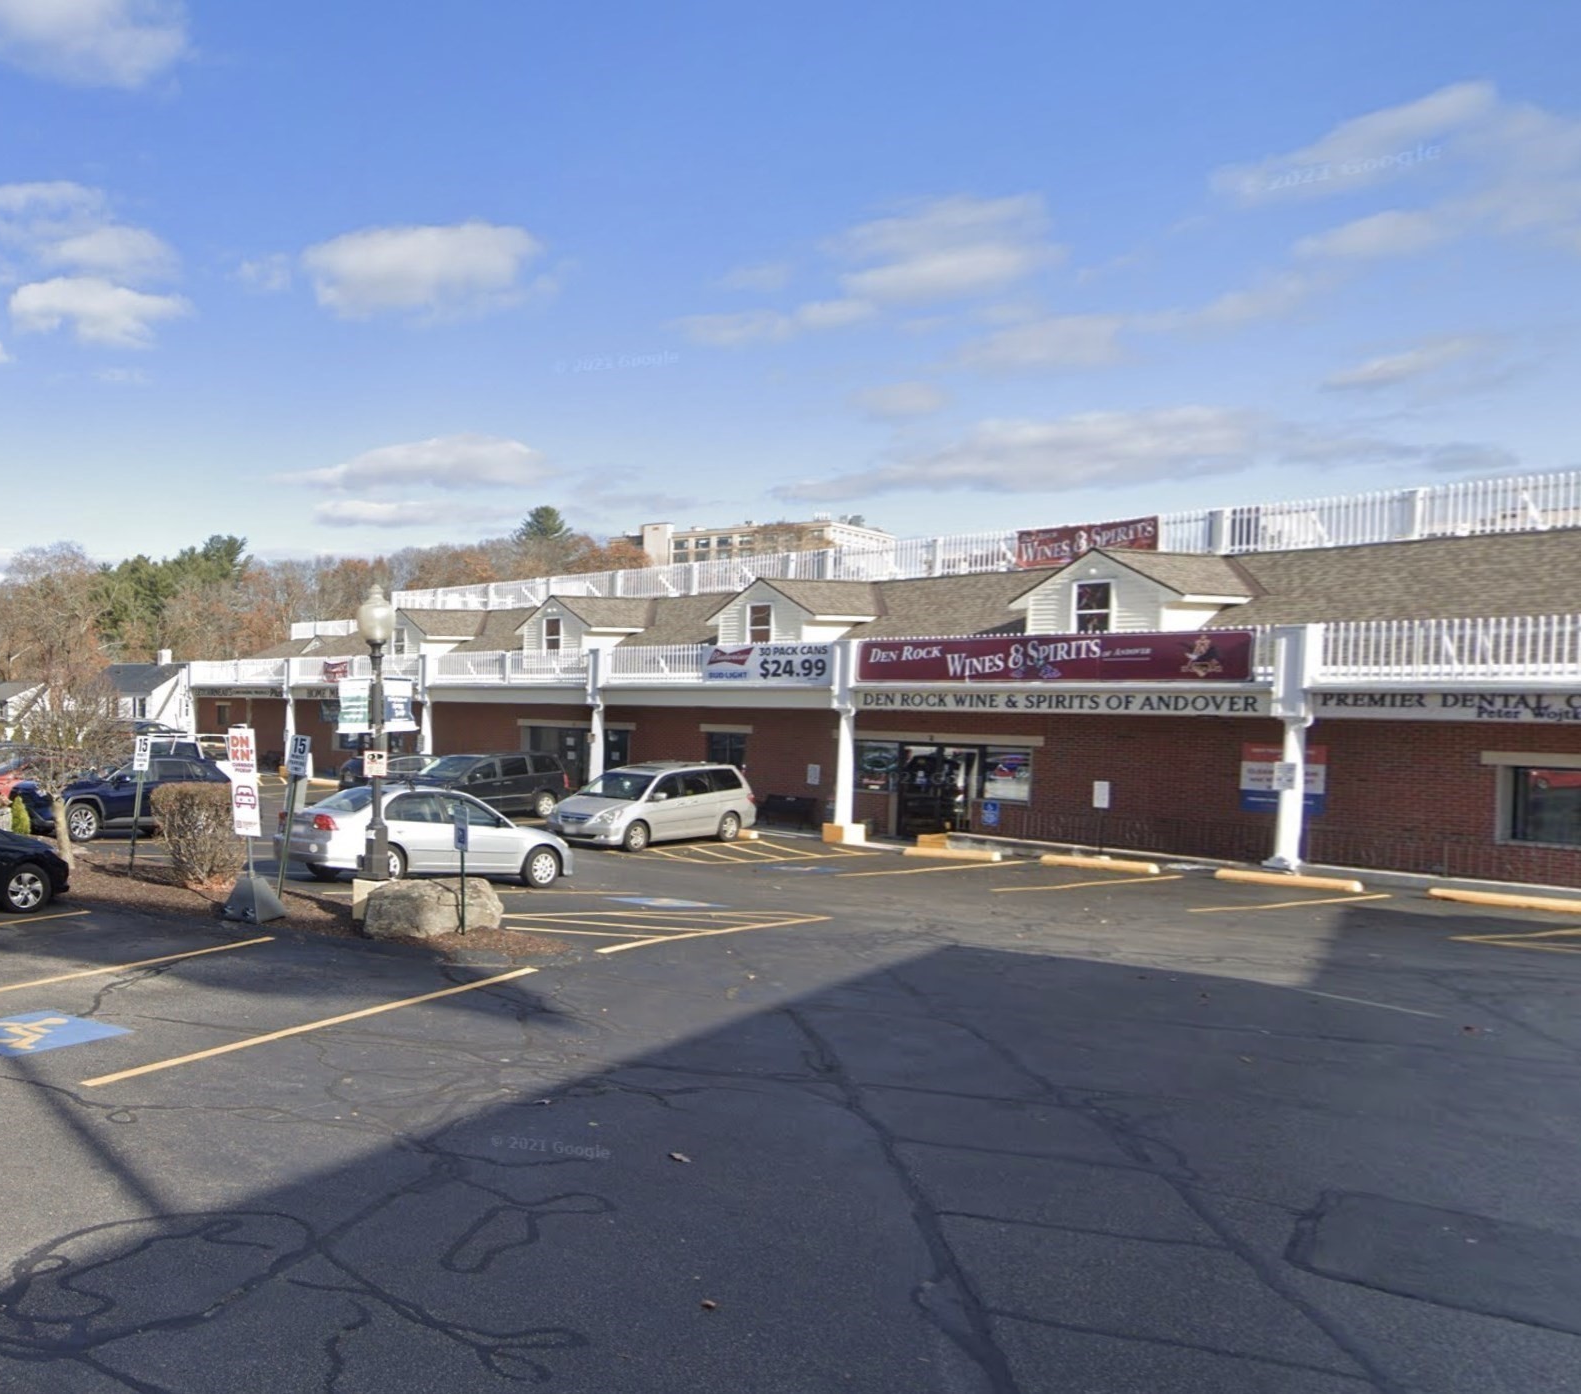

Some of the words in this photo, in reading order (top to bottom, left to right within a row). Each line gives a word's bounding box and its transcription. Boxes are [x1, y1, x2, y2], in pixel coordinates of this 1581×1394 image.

[1021, 540, 1070, 562] WINES
[1089, 521, 1155, 549] SPIRITS
[759, 647, 772, 656] 30
[773, 646, 798, 656] PACK
[800, 645, 828, 655] CANS
[869, 648, 900, 662] DEN
[901, 645, 943, 661] ROCK
[946, 653, 1005, 677] WINES
[1008, 644, 1024, 669] &
[1026, 639, 1101, 666] SPIRITS
[725, 671, 748, 679] LIGHT
[759, 658, 827, 679] $24.99
[863, 692, 896, 707] DEN
[900, 693, 949, 707] ROCK
[953, 693, 999, 708] WINE
[1005, 694, 1019, 709] &
[1024, 694, 1100, 710] SPIRITS
[1105, 694, 1136, 710] OF
[1139, 695, 1259, 712] ANDOVER
[1321, 693, 1427, 708] PREMIER
[1441, 693, 1552, 711] DENTAL
[1477, 705, 1521, 718] Peter
[139, 738, 148, 752] 15
[230, 735, 249, 748] DN
[294, 737, 307, 754] 15
